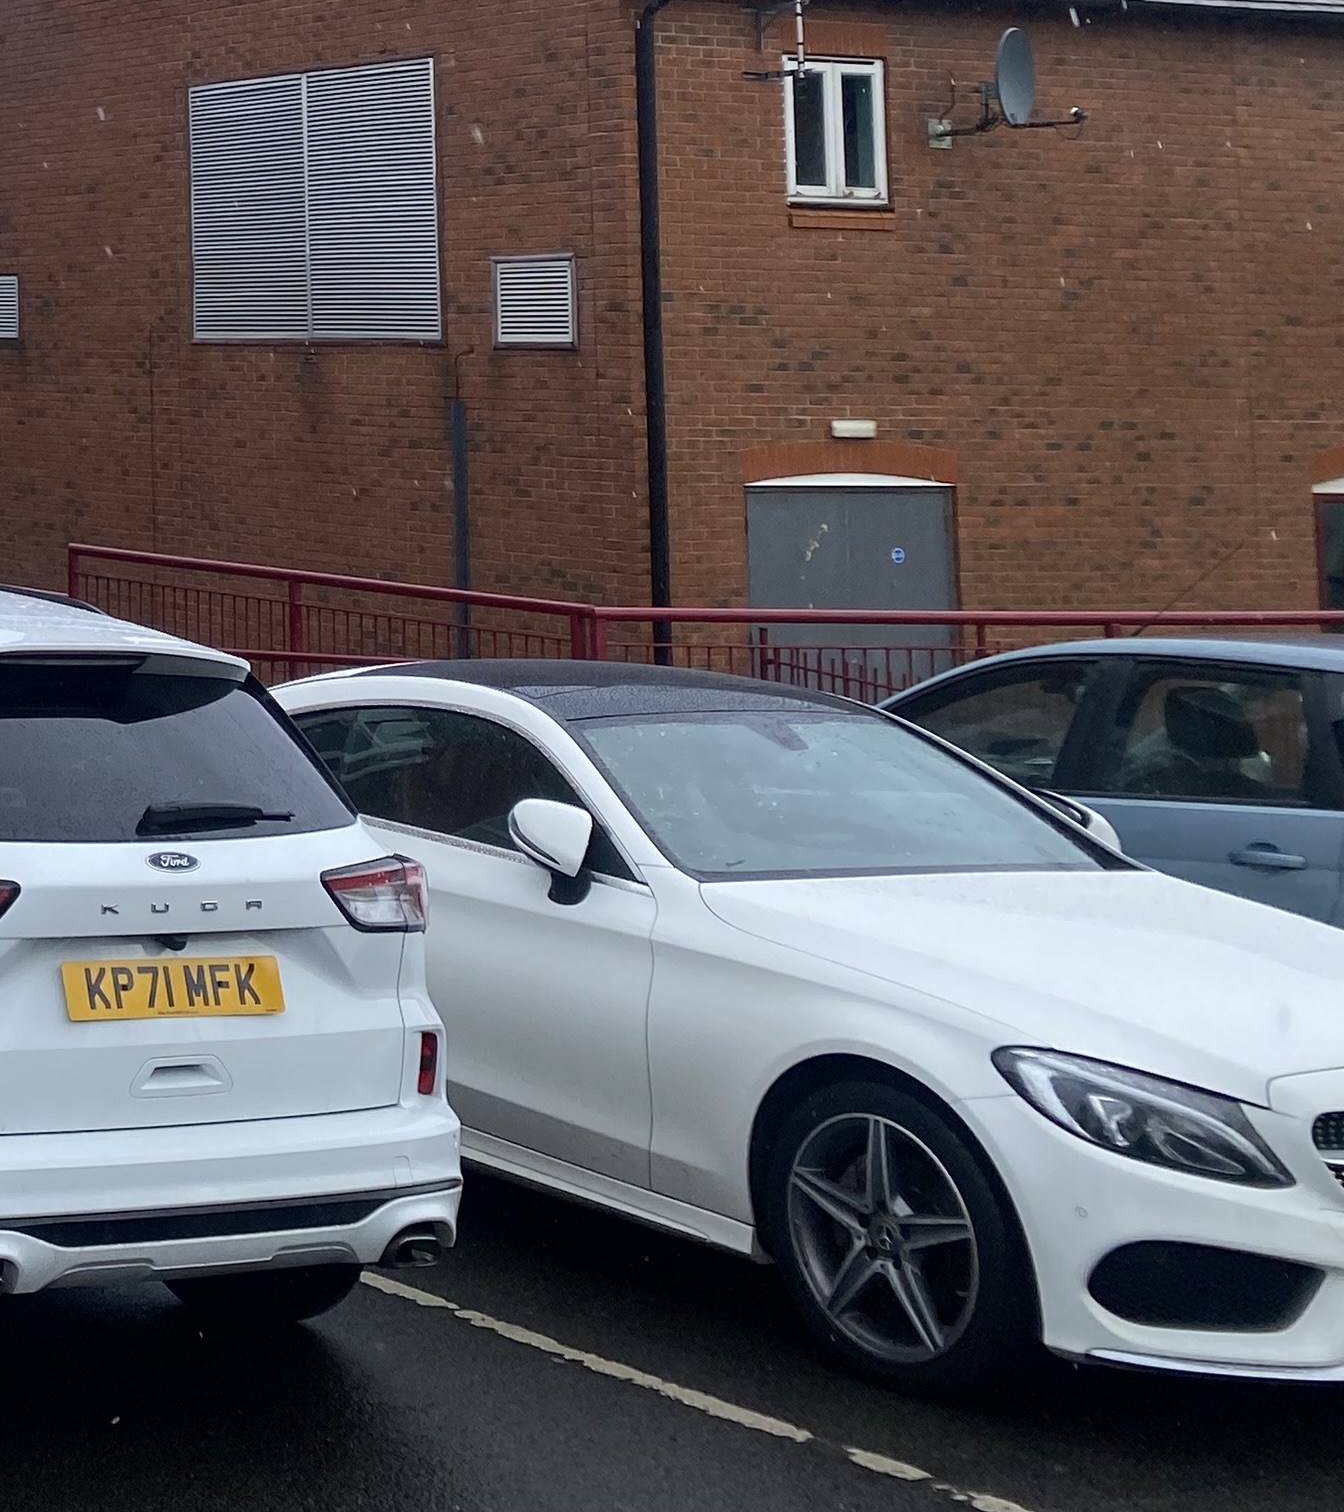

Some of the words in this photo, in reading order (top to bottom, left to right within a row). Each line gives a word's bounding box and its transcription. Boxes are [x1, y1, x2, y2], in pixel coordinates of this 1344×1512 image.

[160, 853, 190, 867] Ford
[100, 898, 263, 916] KUGA
[83, 964, 176, 1011] KP71
[183, 962, 261, 1008] MFK
